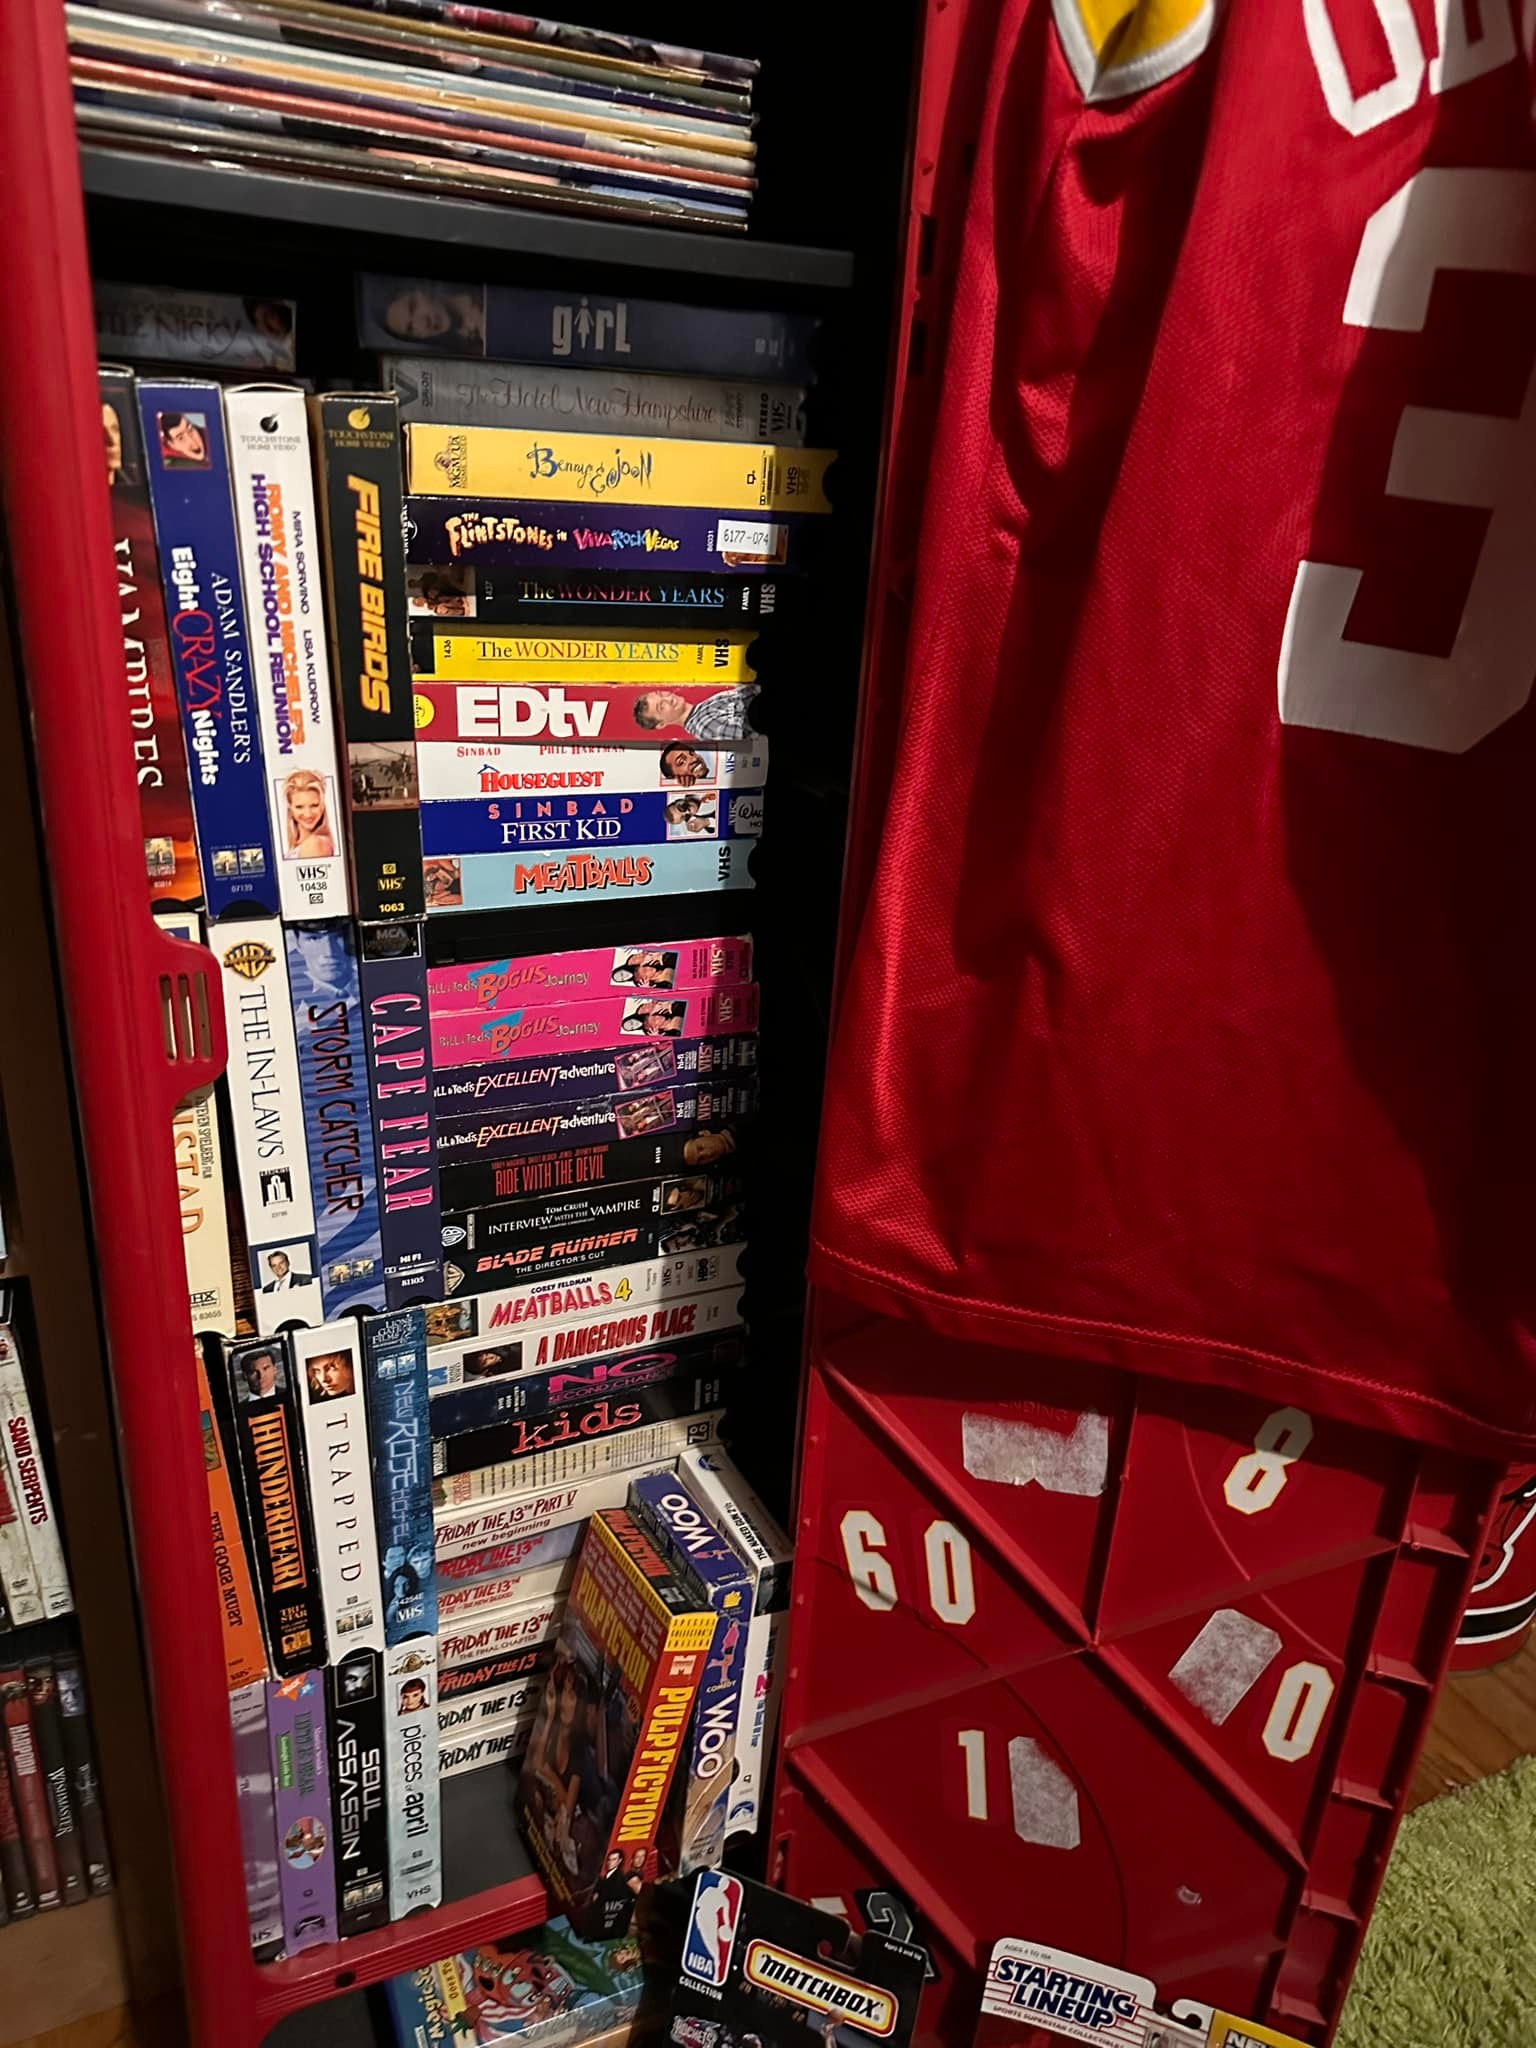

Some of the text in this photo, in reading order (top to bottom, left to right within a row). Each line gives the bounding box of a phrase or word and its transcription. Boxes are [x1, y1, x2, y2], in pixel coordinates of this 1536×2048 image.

[498, 379, 562, 414] Hotel
[563, 388, 610, 414] New
[609, 388, 717, 432] Hampshire
[240, 435, 301, 445] TOUCHSTONE
[328, 430, 394, 441] TOUCHSTONE
[786, 466, 798, 495] VHS
[266, 484, 294, 617] ROMY AND
[724, 529, 769, 545] 6177-074
[519, 581, 725, 604] The WONDER YEARS
[760, 584, 776, 615] VHS
[251, 473, 293, 755] HIGH SCHOOL REUNION
[292, 510, 320, 725] MIRA SORVINO LISA KUDROW
[171, 546, 222, 785] Eight CRAZY Nights
[443, 639, 451, 658] 1436
[477, 640, 679, 660] The WONDER YEARS
[714, 638, 730, 667] VHS
[211, 573, 250, 763] ADAM SANDLER'S
[456, 687, 608, 738] EDtv
[457, 744, 625, 758] SINBAD PHIL HARTMAN
[725, 752, 736, 774] VHS
[480, 770, 604, 793] HOUSEGUEST
[489, 799, 634, 819] SINBAD
[501, 819, 622, 845] FIRST KID
[298, 866, 328, 879] VHS
[514, 854, 654, 893] MEATBALLS
[718, 846, 731, 882] VHS
[300, 881, 328, 891] 10438
[378, 877, 402, 891] VHS
[378, 902, 405, 913] 1063
[711, 948, 725, 977] VHS
[477, 964, 548, 1004] BOGUS
[719, 997, 733, 1023] VHS
[370, 993, 429, 1099] CAPE
[490, 1014, 560, 1055] BOGUS
[240, 984, 284, 1158] THE IN-LAWS
[699, 1044, 713, 1073] VHS
[474, 1062, 616, 1097] EXCELLENT adventure
[308, 1002, 364, 1215] STORM CATCHER
[698, 1092, 712, 1121] VHS
[198, 1103, 213, 1166] STEVEN SPIELBERG
[476, 1111, 616, 1148] EXCELLENT adventure
[379, 1112, 433, 1213] FEAR
[495, 1153, 606, 1197] RIDE WITH THE DEVIL
[488, 1214, 554, 1236] INTERVIEW
[554, 1213, 574, 1222] WITH
[575, 1210, 588, 1219] THE
[590, 1198, 641, 1216] VAMPIRE
[545, 1202, 588, 1216] TOM CRUISE
[476, 1228, 640, 1274] BLADE RUNNER
[515, 1250, 605, 1275] THE DIRECTOR'S CUT
[531, 1276, 592, 1295] COREY FELDMAN
[697, 1259, 710, 1282] HBO
[489, 1278, 632, 1329] MEATBALLS 4
[536, 1303, 697, 1366] A DANGEROUS PLACE
[549, 1352, 678, 1394] NO
[549, 1368, 674, 1404] SECOND CHANCE
[8, 1416, 32, 1458] SAND
[511, 1401, 642, 1455] kids
[1224, 1407, 1313, 1514] 8
[18, 1457, 48, 1526] SERPENTS
[248, 1404, 308, 1592] THUNDERHEART
[325, 1412, 362, 1583] TRAPPED
[389, 1487, 411, 1544] HOTEL
[436, 1489, 578, 1545] FRIDAY THE 13TH PART V
[661, 1493, 715, 1552] WOO
[462, 1519, 551, 1551] new beginning
[489, 1544, 515, 1562] THE
[213, 1545, 244, 1627] GODS MUST
[473, 1582, 498, 1600] THE
[398, 1604, 424, 1621] VHS
[442, 1612, 555, 1659] FRIDAY THE 13TH
[459, 1634, 538, 1661] THE FINAL CHAPTER
[600, 1602, 651, 1696] FICTION
[438, 1659, 519, 1694] FRIDAY THE
[480, 1697, 507, 1717] THE
[9, 1724, 37, 1777] HARPOON
[486, 1734, 516, 1754] THE
[697, 1692, 737, 1779] WOO
[617, 1686, 695, 1841] PULP FICTION
[337, 1719, 361, 1861] ASSASSIN
[362, 1748, 382, 1822] SOUL
[400, 1725, 430, 1840] pieces april
[48, 1766, 73, 1837] WISHMASTER
[406, 1884, 431, 1899] VHS
[687, 1951, 714, 1976] NBA
[679, 1976, 723, 2001] COLLECTION
[998, 1958, 1134, 2018] STARTING
[1013, 1984, 1115, 2028] LINEUP
[993, 2003, 1067, 2032] SPORTS SUPERSTAR
